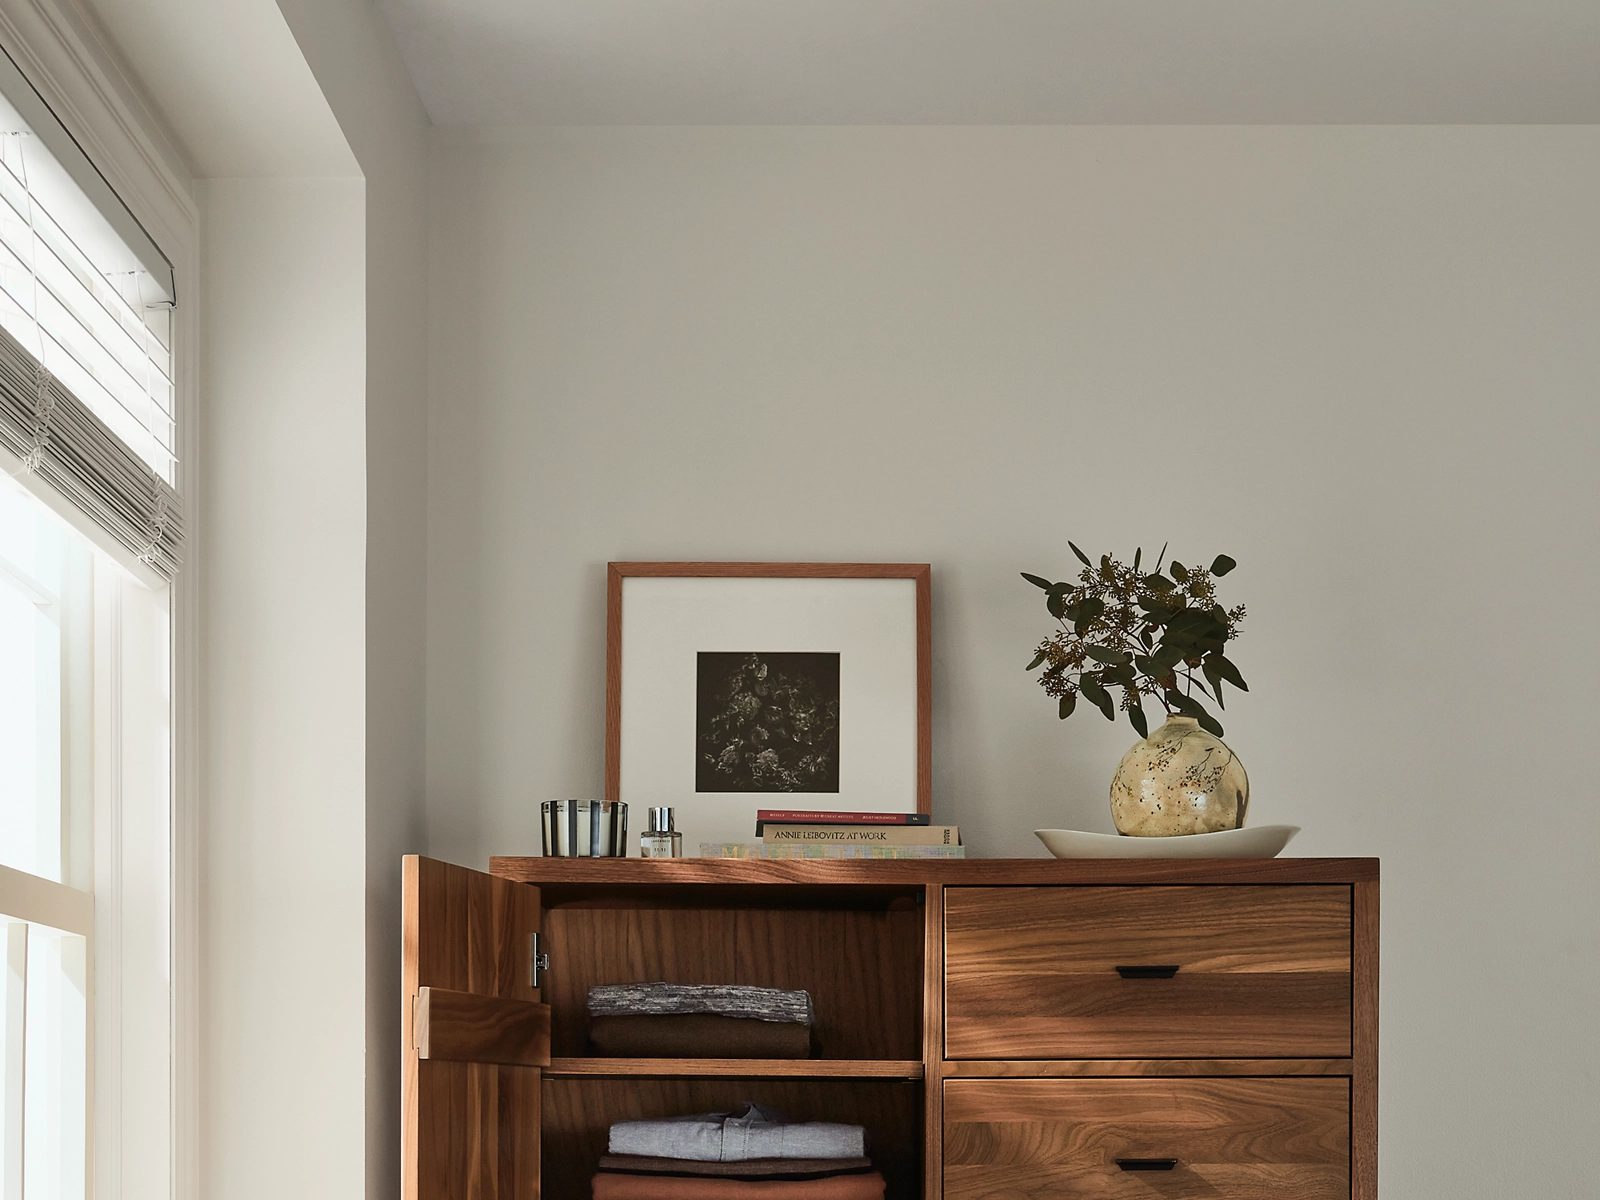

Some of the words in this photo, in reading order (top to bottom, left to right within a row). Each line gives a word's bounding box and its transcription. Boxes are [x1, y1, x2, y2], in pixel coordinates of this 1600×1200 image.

[774, 831, 801, 839] ANNIE
[802, 831, 845, 840] LEIBOVITZ
[846, 832, 859, 840] AT
[859, 832, 887, 840] WORK
